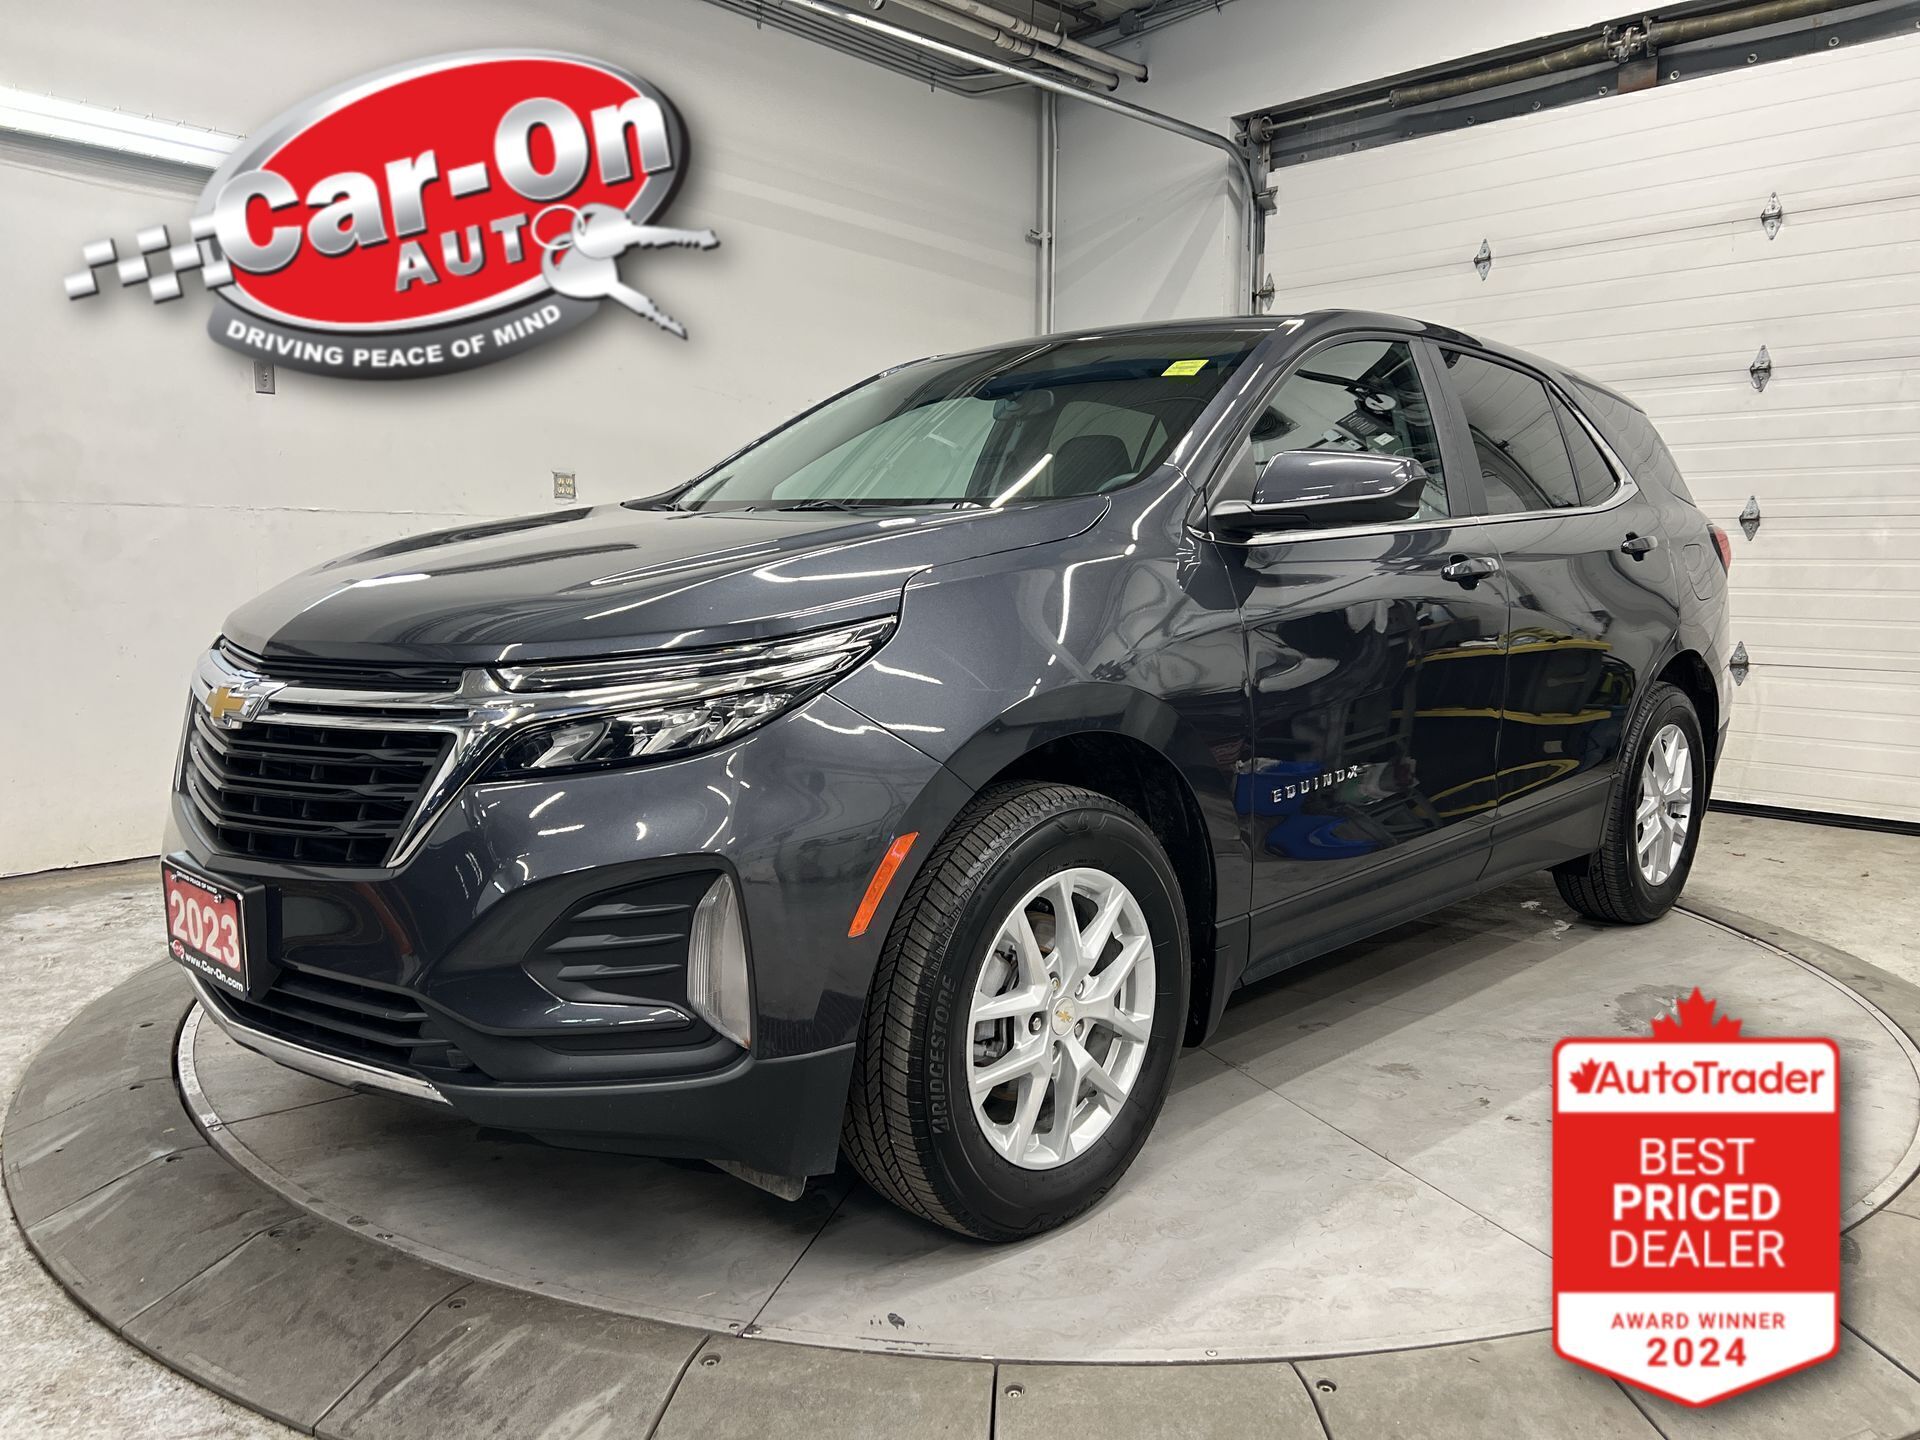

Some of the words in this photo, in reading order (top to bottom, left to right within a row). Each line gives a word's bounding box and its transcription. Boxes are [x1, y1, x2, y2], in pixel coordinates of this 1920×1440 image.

[1272, 764, 1359, 803] EQUINOX
[170, 889, 241, 968] 2023
[185, 953, 244, 993] www.Car-On.com
[930, 974, 957, 1134] BRIDGESTONE
